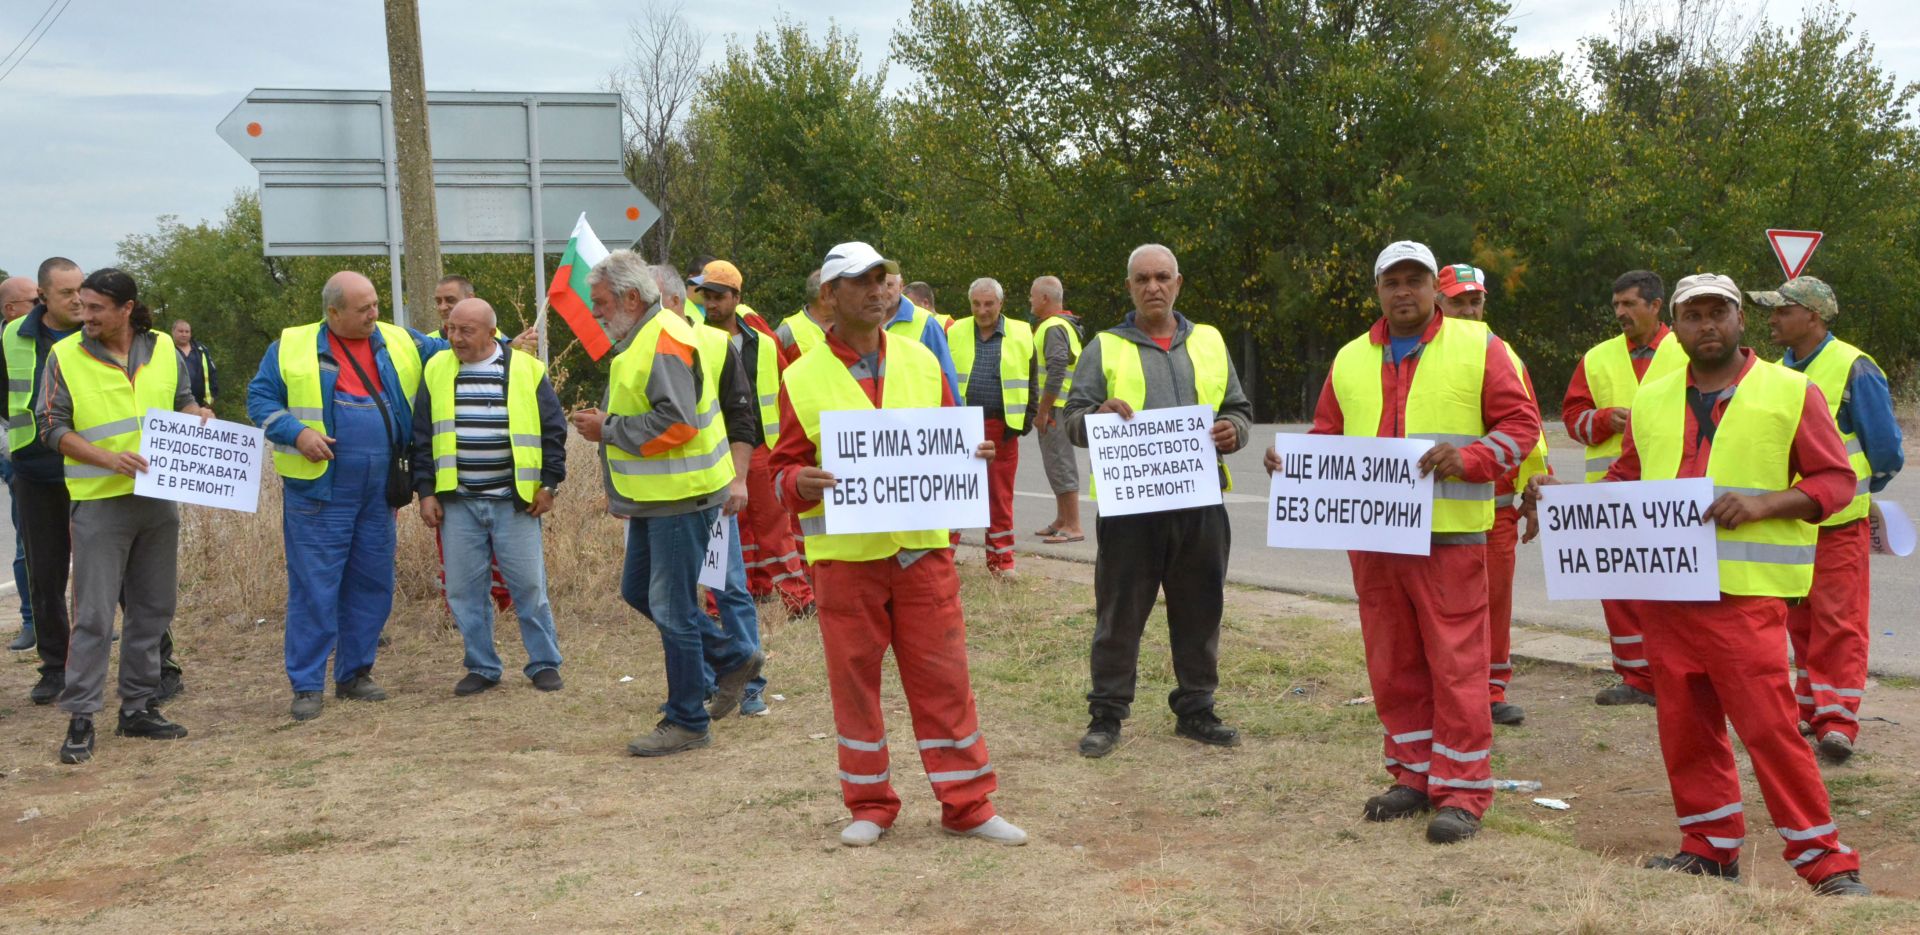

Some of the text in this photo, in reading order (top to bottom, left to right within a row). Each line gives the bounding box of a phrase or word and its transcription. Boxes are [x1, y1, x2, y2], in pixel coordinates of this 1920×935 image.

[149, 418, 256, 449] СЪЖАЛЯВАМЕ ЗА
[1092, 417, 1206, 440] СЪЖАЛЯВАМЕ ЗА
[150, 437, 251, 467] НЕУДОБСТВОТО,
[837, 428, 970, 463] ЩЕ ИМА ЗИМА,
[1098, 437, 1203, 461] НЕУДОБСТВОТО,
[149, 455, 248, 481] НО ДЪРЖАВАТА
[1103, 458, 1204, 482] НО ДЪРЖАВАТА
[1285, 453, 1416, 489] ЩЕ ИМА ЗИМА,
[157, 474, 235, 497] Е В РЕМОНТ!
[832, 473, 979, 505] БЕЗ СНЕГОРИНИ
[1115, 479, 1196, 500] Е В РЕМОНТ!
[1276, 496, 1422, 528] БЕЗ СНЕГОРИНИ
[1547, 500, 1703, 531] ЗИМАТА ЧУКА
[1558, 546, 1699, 574] НА ВРАТАТА!
